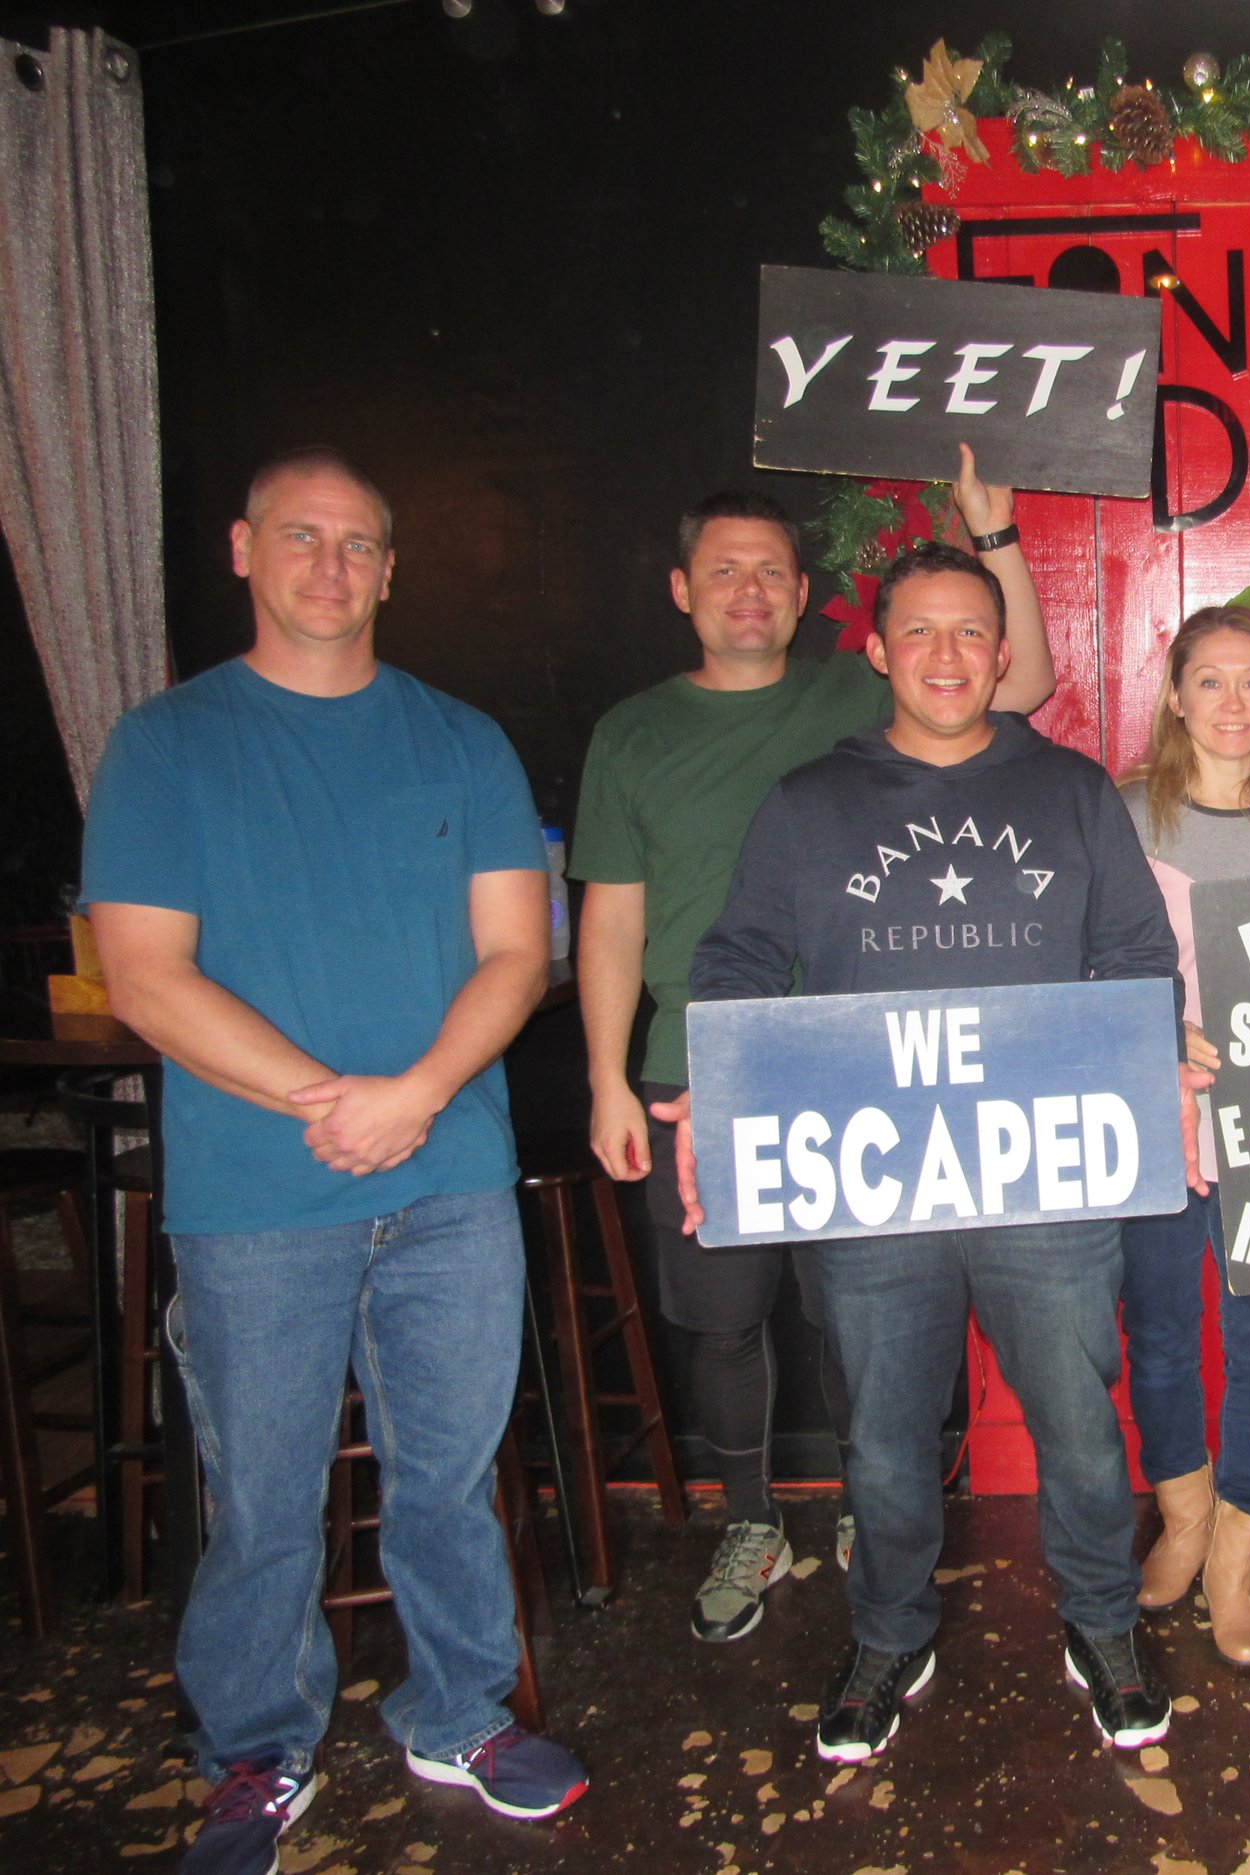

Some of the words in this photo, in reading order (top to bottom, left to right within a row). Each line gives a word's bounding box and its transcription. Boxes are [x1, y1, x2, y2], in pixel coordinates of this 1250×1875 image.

[771, 335, 1147, 421] YEET!
[845, 816, 1055, 904] BANANA
[861, 922, 1043, 953] REPUBLIC
[886, 1007, 984, 1088] WE
[733, 1093, 1140, 1234] ESCAPED
